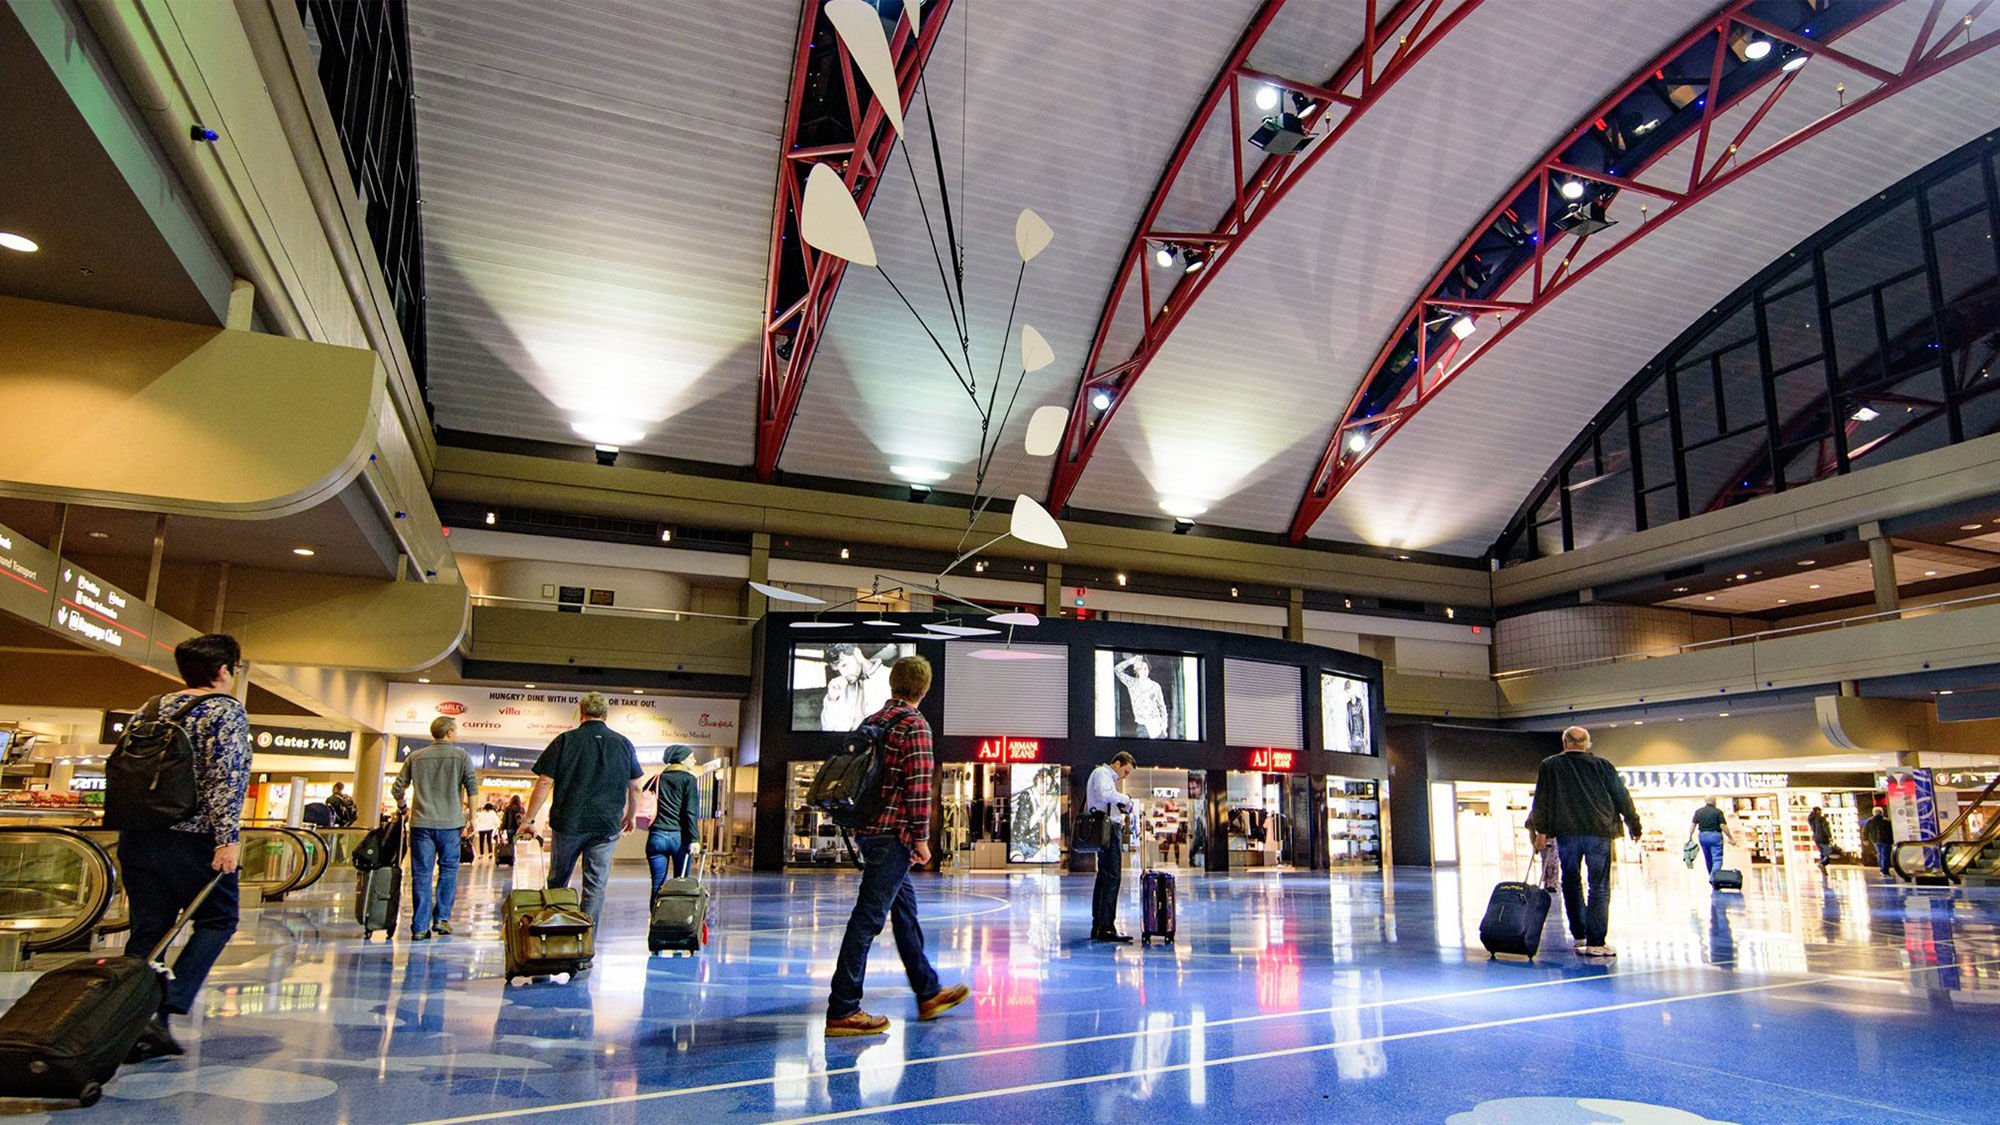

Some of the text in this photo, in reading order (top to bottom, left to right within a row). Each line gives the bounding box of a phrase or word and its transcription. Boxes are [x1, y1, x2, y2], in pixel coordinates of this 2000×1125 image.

[489, 692, 525, 701] HUNGRY?
[527, 694, 545, 702] DINE
[547, 695, 567, 703] WITH
[608, 698, 619, 706] OR
[621, 699, 639, 707] TAKE
[498, 706, 521, 716] villa
[462, 720, 502, 729] currito
[274, 735, 310, 749] Gates
[311, 738, 347, 751] 76-100
[978, 740, 1039, 758] AJ ARMANI
[1010, 750, 1036, 759] JEANS
[1253, 751, 1268, 767] AJ
[1617, 771, 1747, 789] OLLEZIONI
